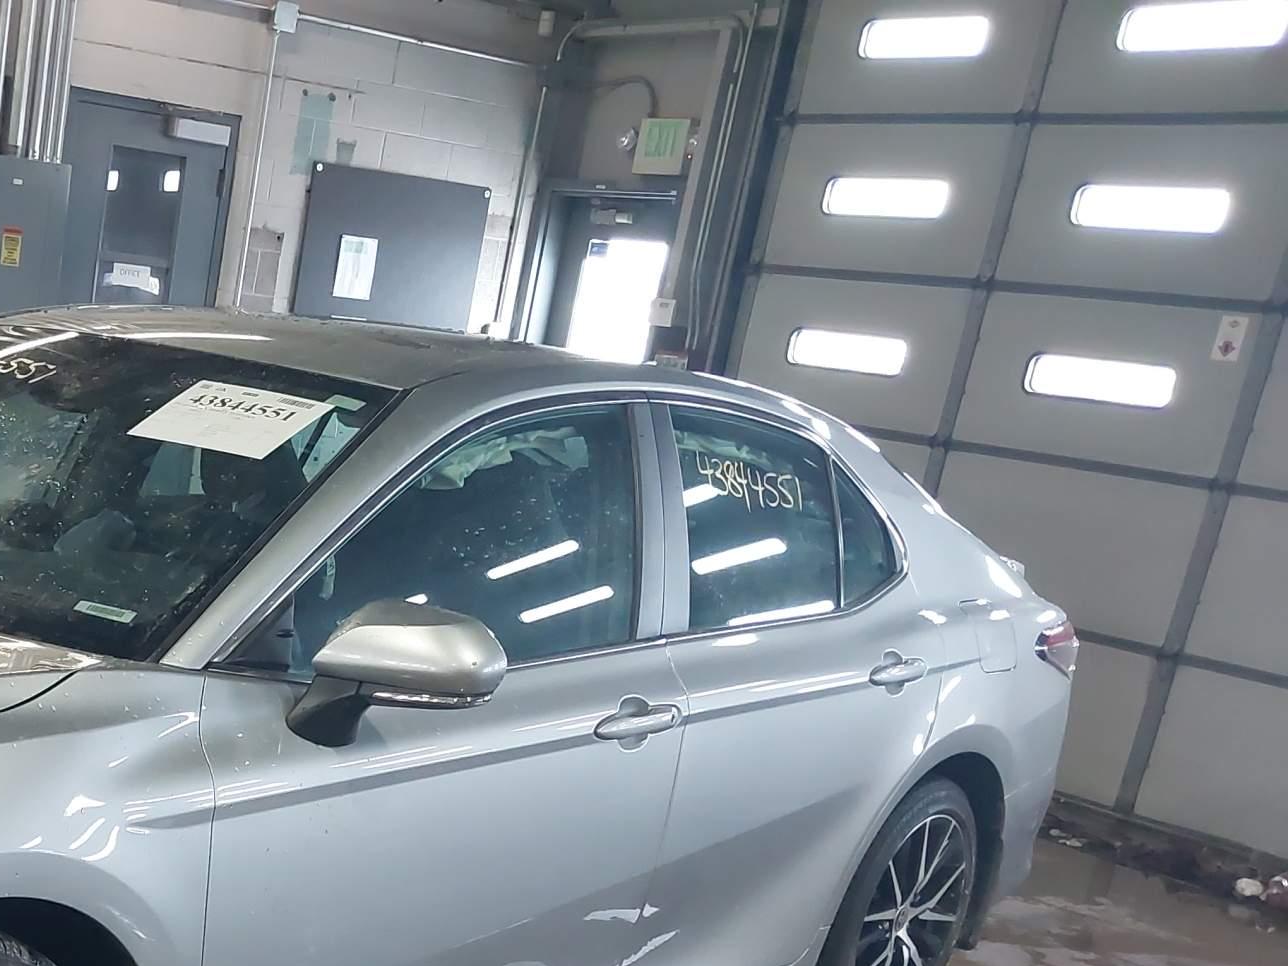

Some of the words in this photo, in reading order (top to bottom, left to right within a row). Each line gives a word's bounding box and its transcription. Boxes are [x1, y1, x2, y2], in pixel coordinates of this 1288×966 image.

[644, 122, 679, 157] EXIT
[189, 393, 297, 422] 43844551
[695, 447, 803, 513] 43844551
